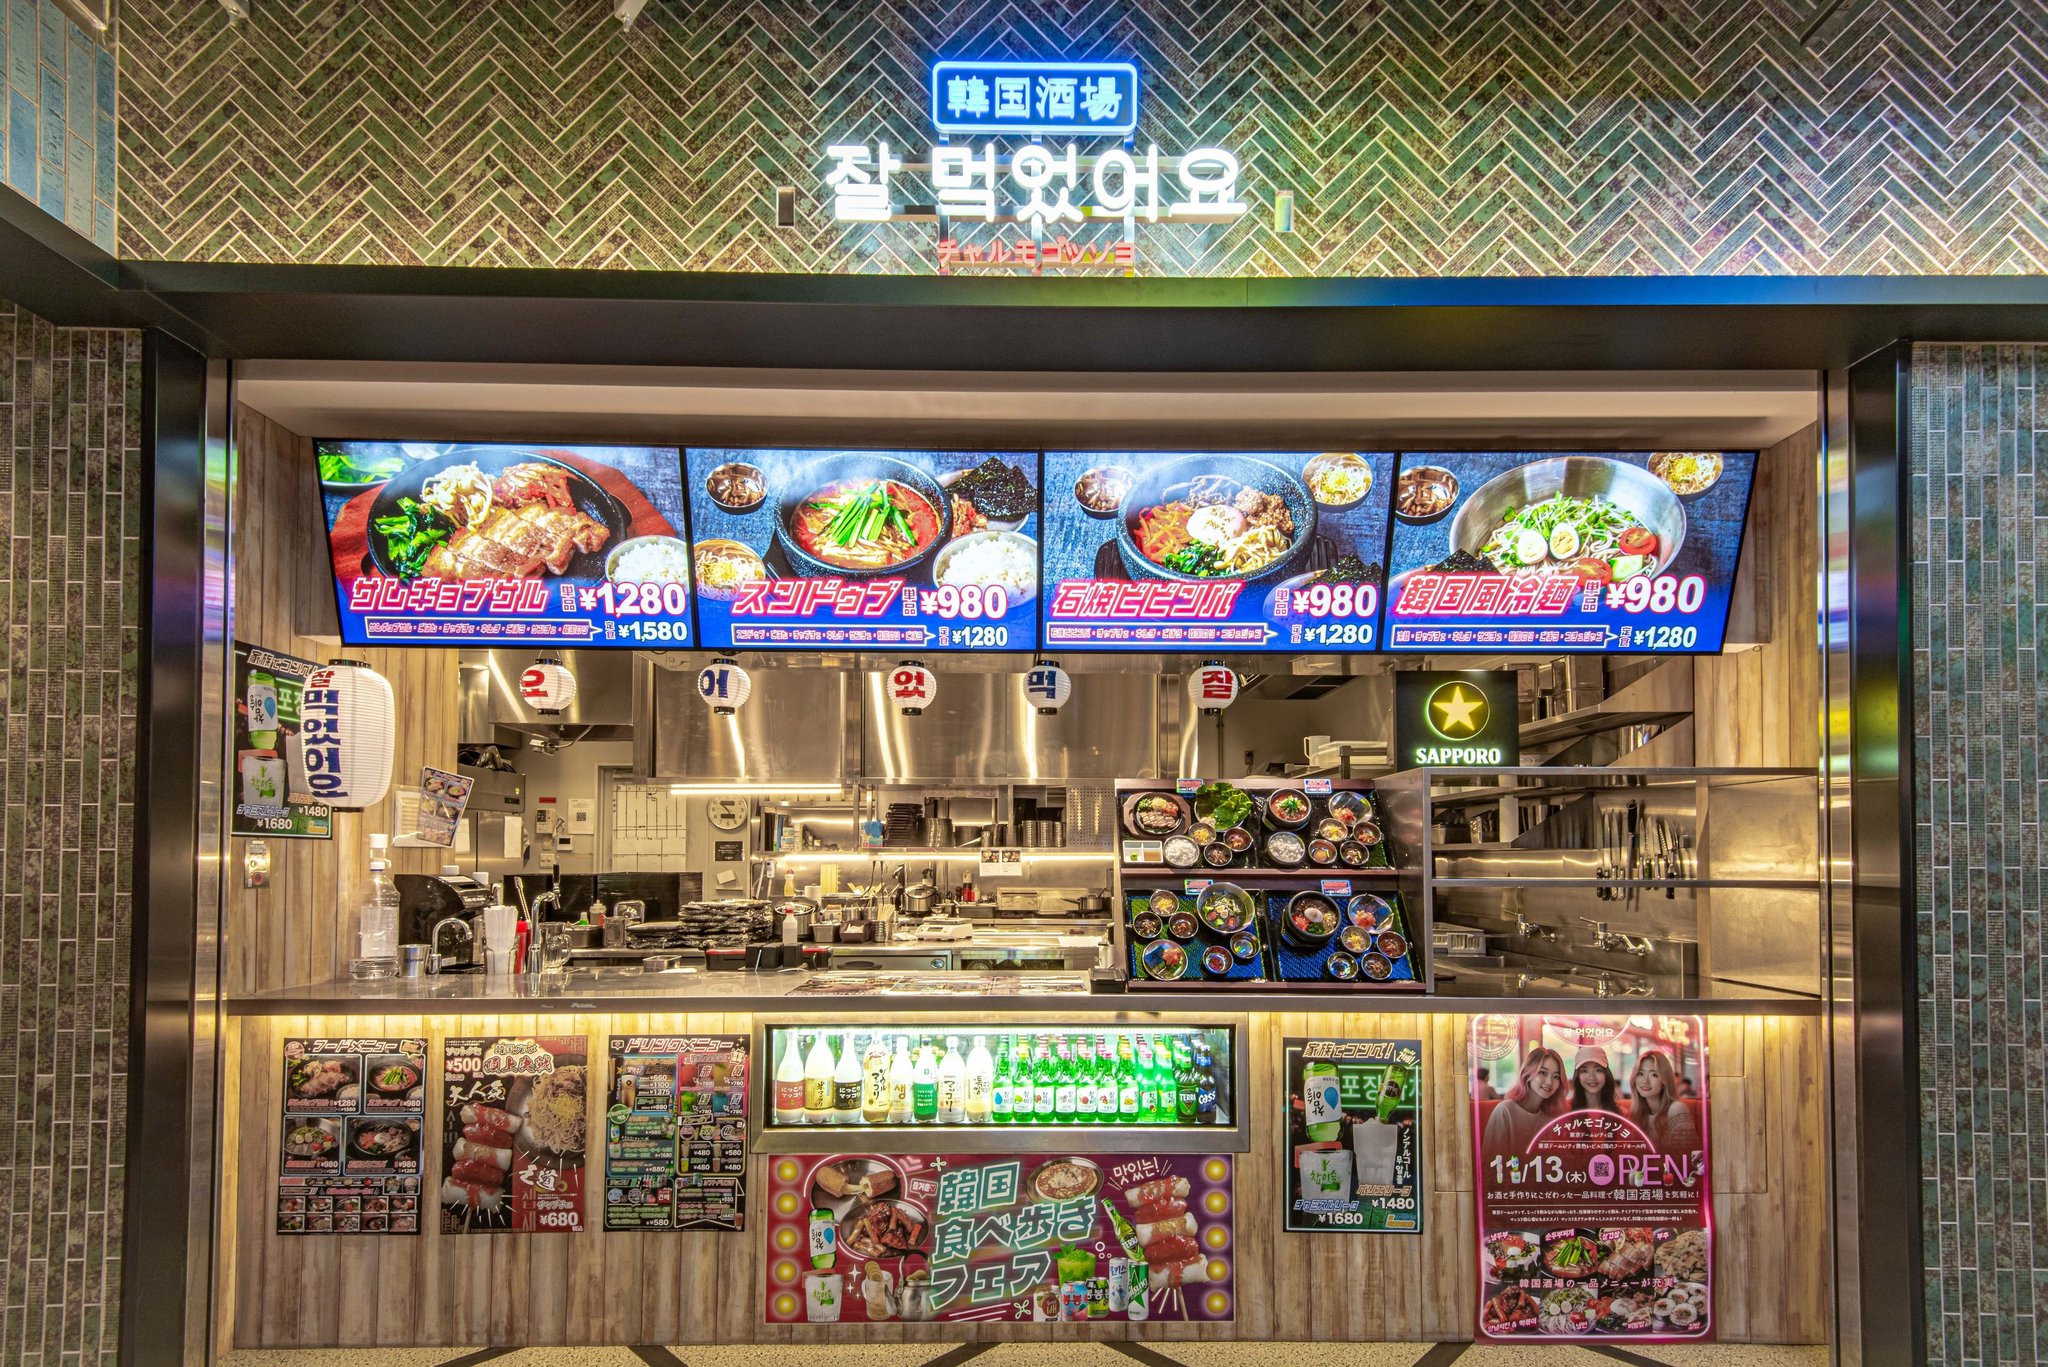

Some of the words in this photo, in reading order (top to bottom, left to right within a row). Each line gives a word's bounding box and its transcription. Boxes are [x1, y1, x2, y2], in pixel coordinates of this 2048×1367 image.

[947, 76, 1123, 120] 韓国酒場
[825, 142, 901, 221] 잘
[931, 142, 1248, 223] 먹었어요
[937, 238, 1135, 266] チャルモゴッソヨ
[350, 577, 548, 612] サムギョプサル
[579, 583, 686, 617] ¥1,280
[731, 579, 902, 616] スンドゥブ
[920, 584, 1008, 619] ¥980
[1052, 581, 1240, 617] 石焼ビビンバ
[1293, 584, 1377, 618] ¥980
[1606, 574, 1705, 614] ¥980
[618, 620, 687, 642] ¥1,580
[952, 627, 1008, 648] ¥1,280
[1304, 624, 1373, 646] ¥1,280
[1633, 626, 1696, 651] ¥1,280
[700, 669, 729, 699] 어
[1027, 670, 1057, 699] 먹
[1202, 670, 1232, 699] 잘
[1416, 748, 1501, 764] SAPPORO
[312, 1040, 398, 1053] フードメニュー
[624, 1037, 734, 1053] ドリンクメニュー
[446, 1057, 481, 1073] ¥500
[484, 1054, 553, 1073] 頂上決戦
[450, 1079, 506, 1106] 大人気
[894, 1084, 906, 1100] 생
[944, 1080, 955, 1112] マッコリ
[1553, 1117, 1630, 1138] チャルモゴッソヨ
[1402, 1127, 1411, 1178] ノンアルコール
[1113, 1157, 1160, 1185] 맛있는!
[937, 1161, 1020, 1215] 韓国
[540, 1212, 579, 1226] ¥680
[932, 1195, 1096, 1264] 食べ歩き
[929, 1251, 1051, 1311] フェア
[1519, 1278, 1675, 1289] 韓国酒場の一品メニューが充実
